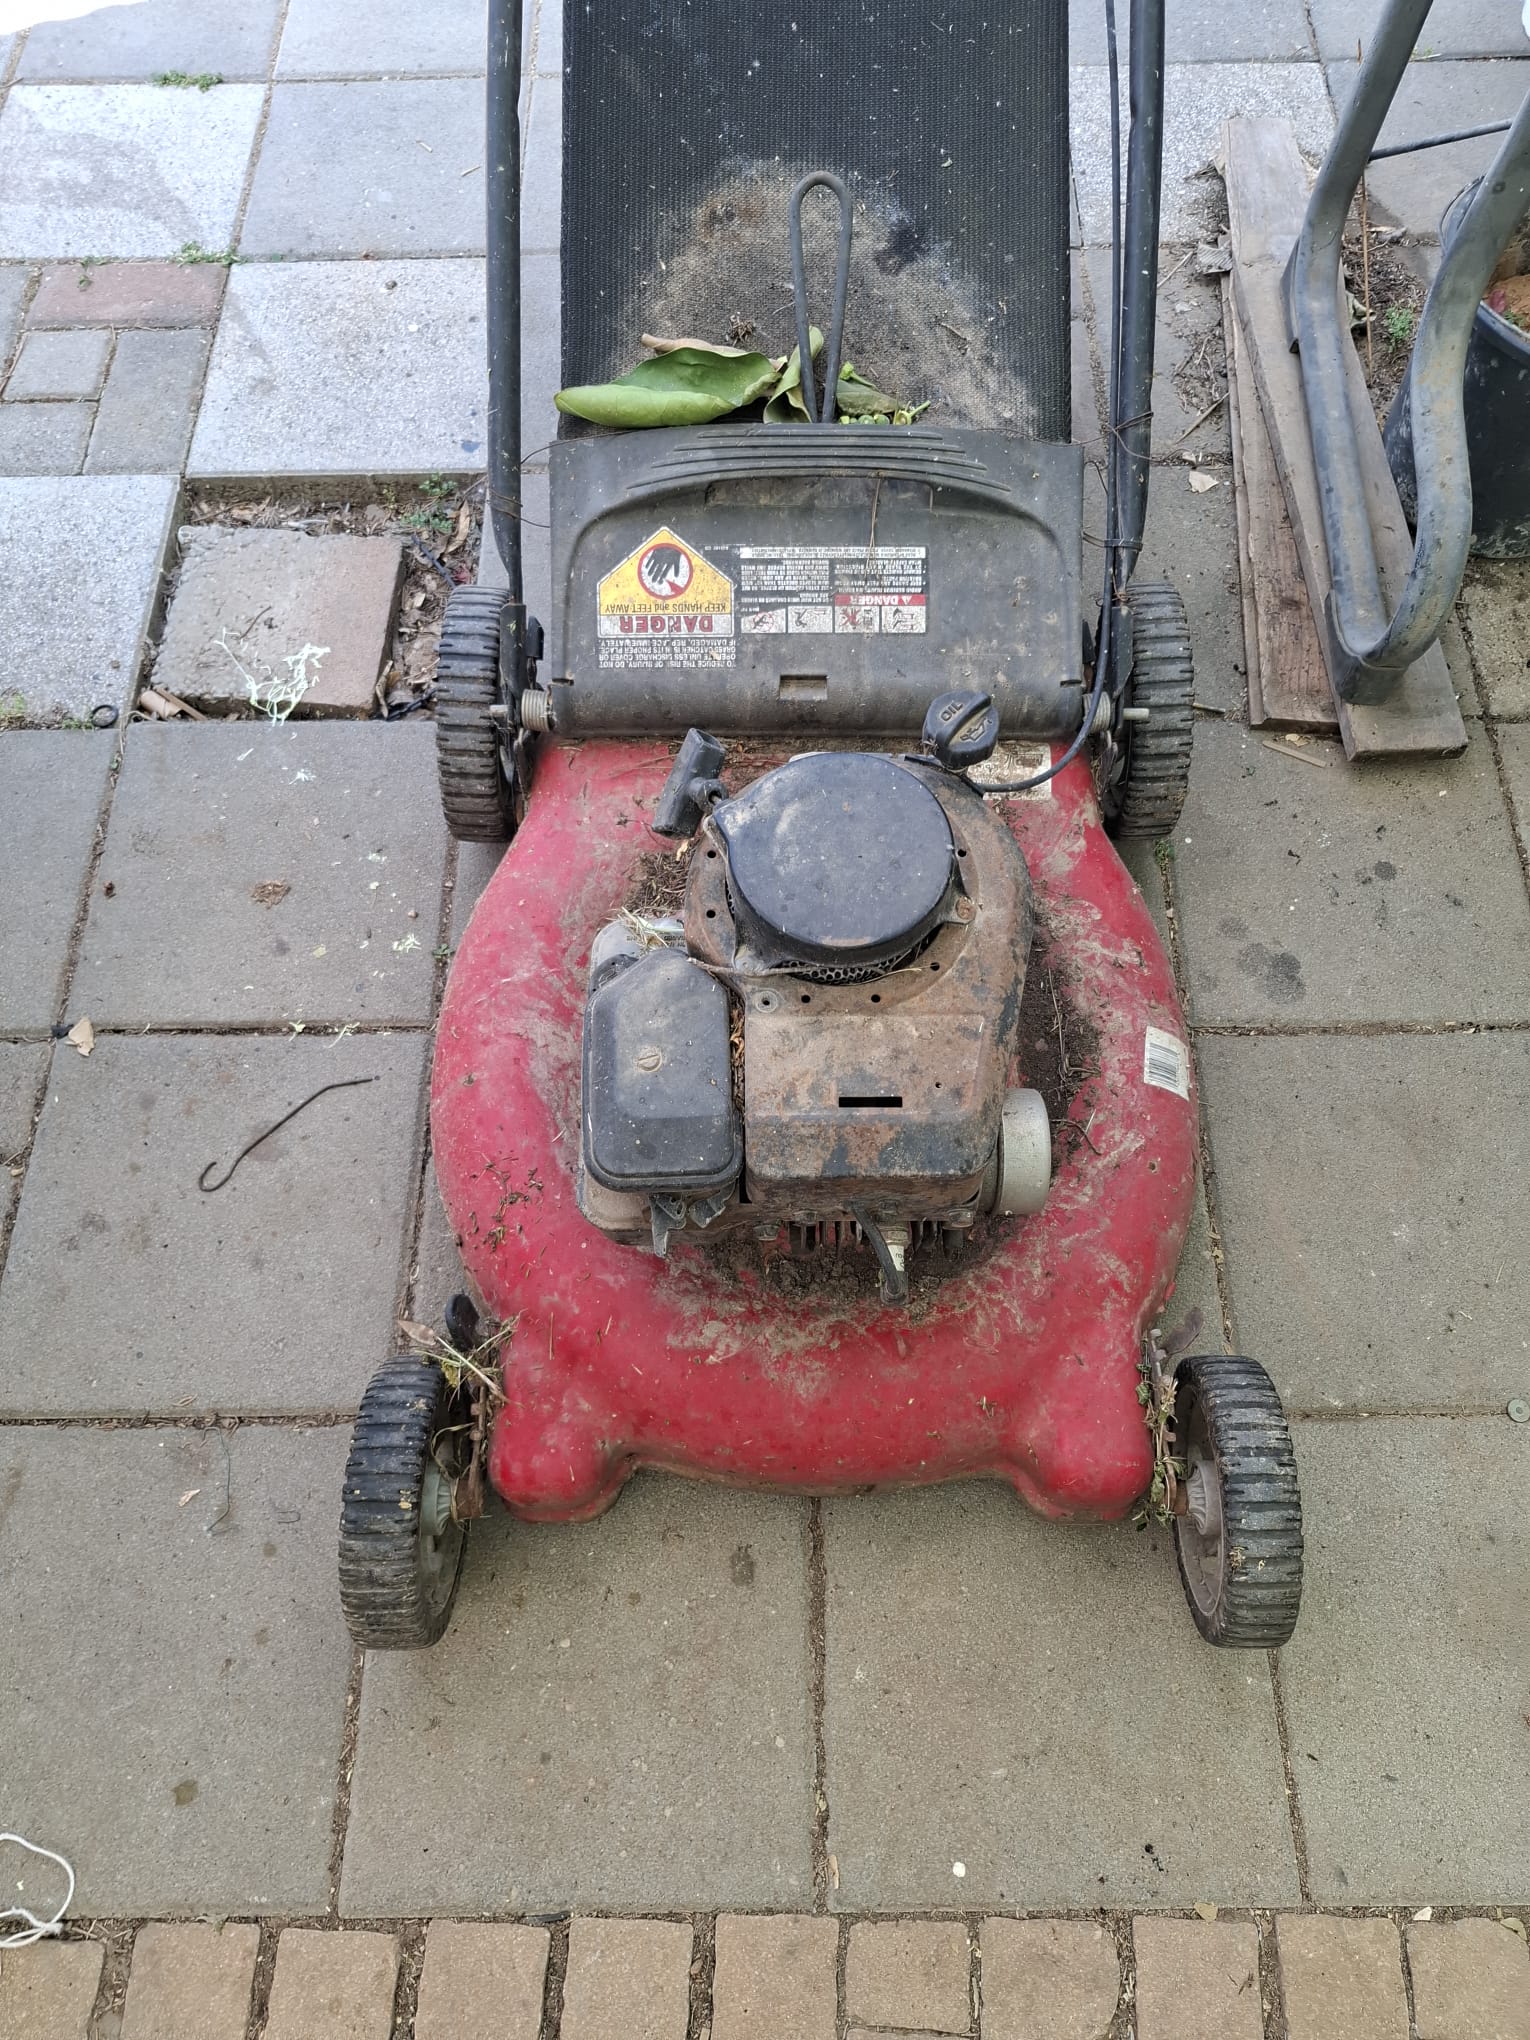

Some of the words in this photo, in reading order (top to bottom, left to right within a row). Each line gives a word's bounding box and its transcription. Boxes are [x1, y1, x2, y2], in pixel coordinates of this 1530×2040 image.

[850, 595, 899, 605] DANGER
[605, 604, 629, 613] AWAY
[632, 604, 651, 612] FEET
[655, 604, 669, 612] and
[673, 603, 702, 612] HANDS
[705, 603, 725, 612] KEEP
[620, 616, 713, 633] DANGER
[941, 701, 964, 722] OIL
